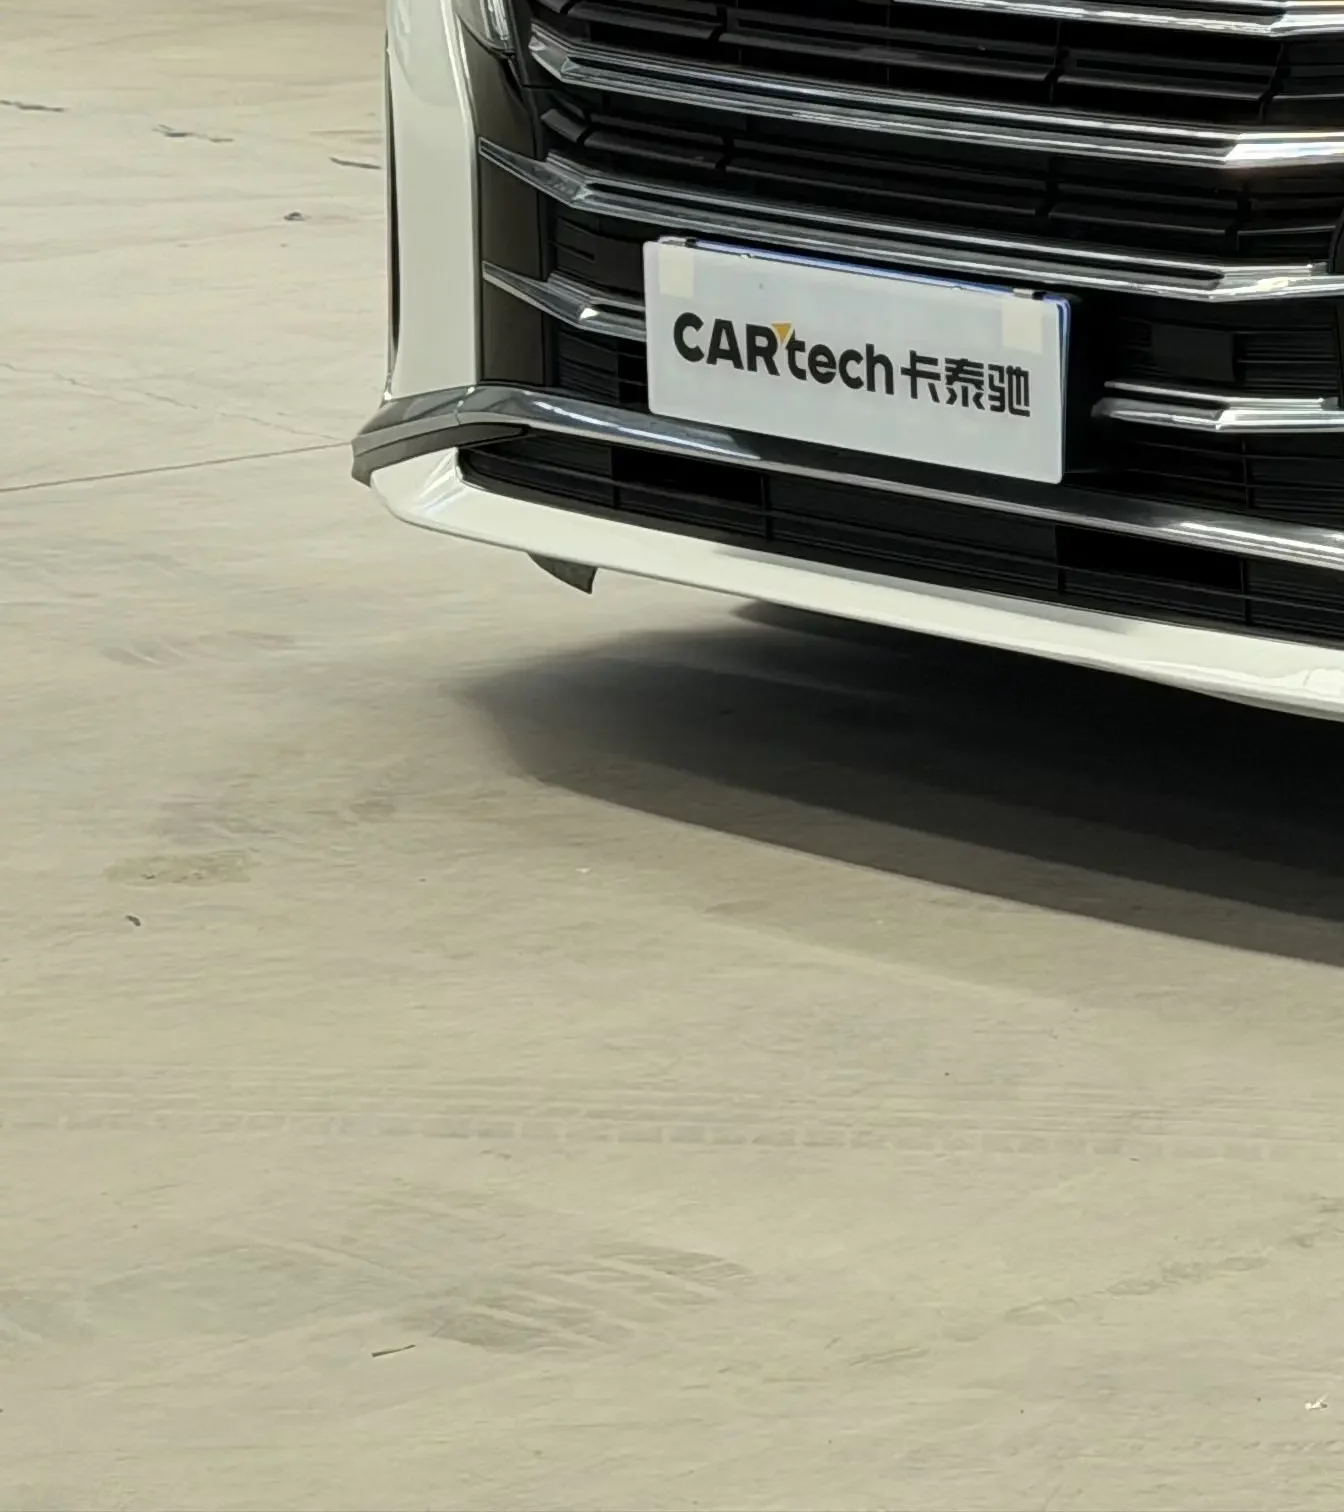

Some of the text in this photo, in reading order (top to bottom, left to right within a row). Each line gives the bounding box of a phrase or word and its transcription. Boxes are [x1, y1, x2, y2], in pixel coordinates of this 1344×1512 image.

[673, 312, 1031, 418] CARtech 卡泰驰
